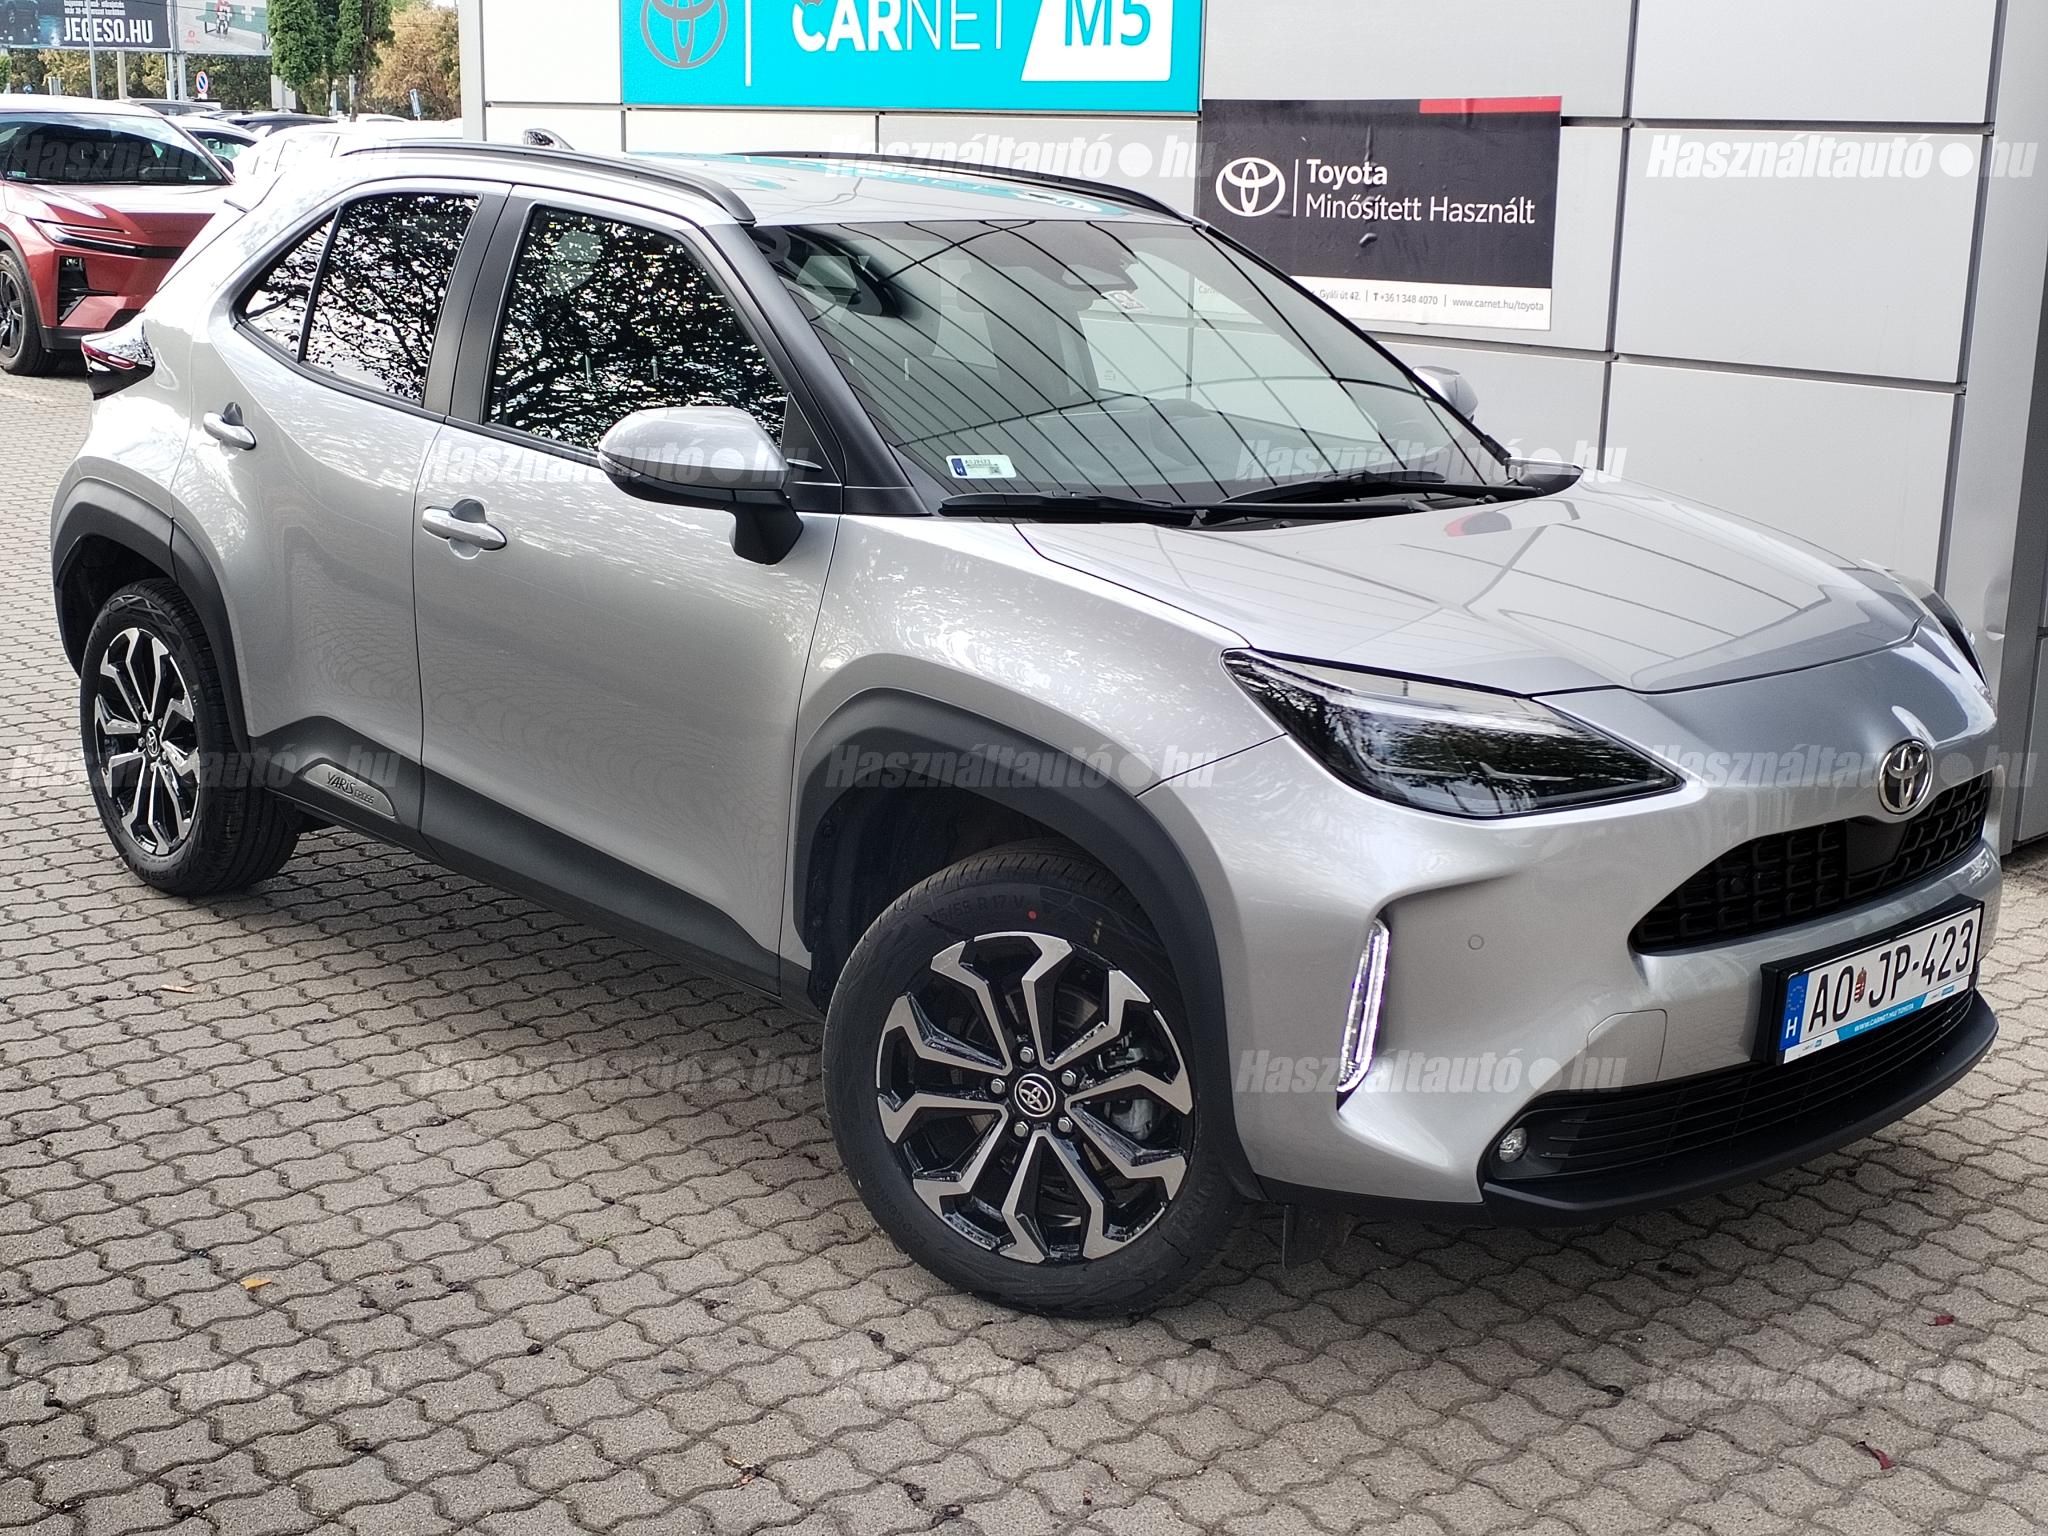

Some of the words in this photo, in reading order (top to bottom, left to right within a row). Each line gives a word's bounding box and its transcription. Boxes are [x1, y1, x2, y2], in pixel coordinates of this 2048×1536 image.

[791, 0, 1003, 52] CARNET
[1064, 0, 1153, 47] M5
[1305, 158, 1388, 190] Toyota
[1305, 192, 1422, 222] Minősített
[1429, 195, 1536, 225] Használt
[1401, 294, 1417, 304] 348
[1418, 295, 1439, 305] 4070
[1452, 299, 1544, 313] www.carnet.hu/toyota
[1808, 965, 1854, 1033] AO
[1868, 918, 1974, 1008] JP-423
[1785, 1016, 1798, 1040] H
